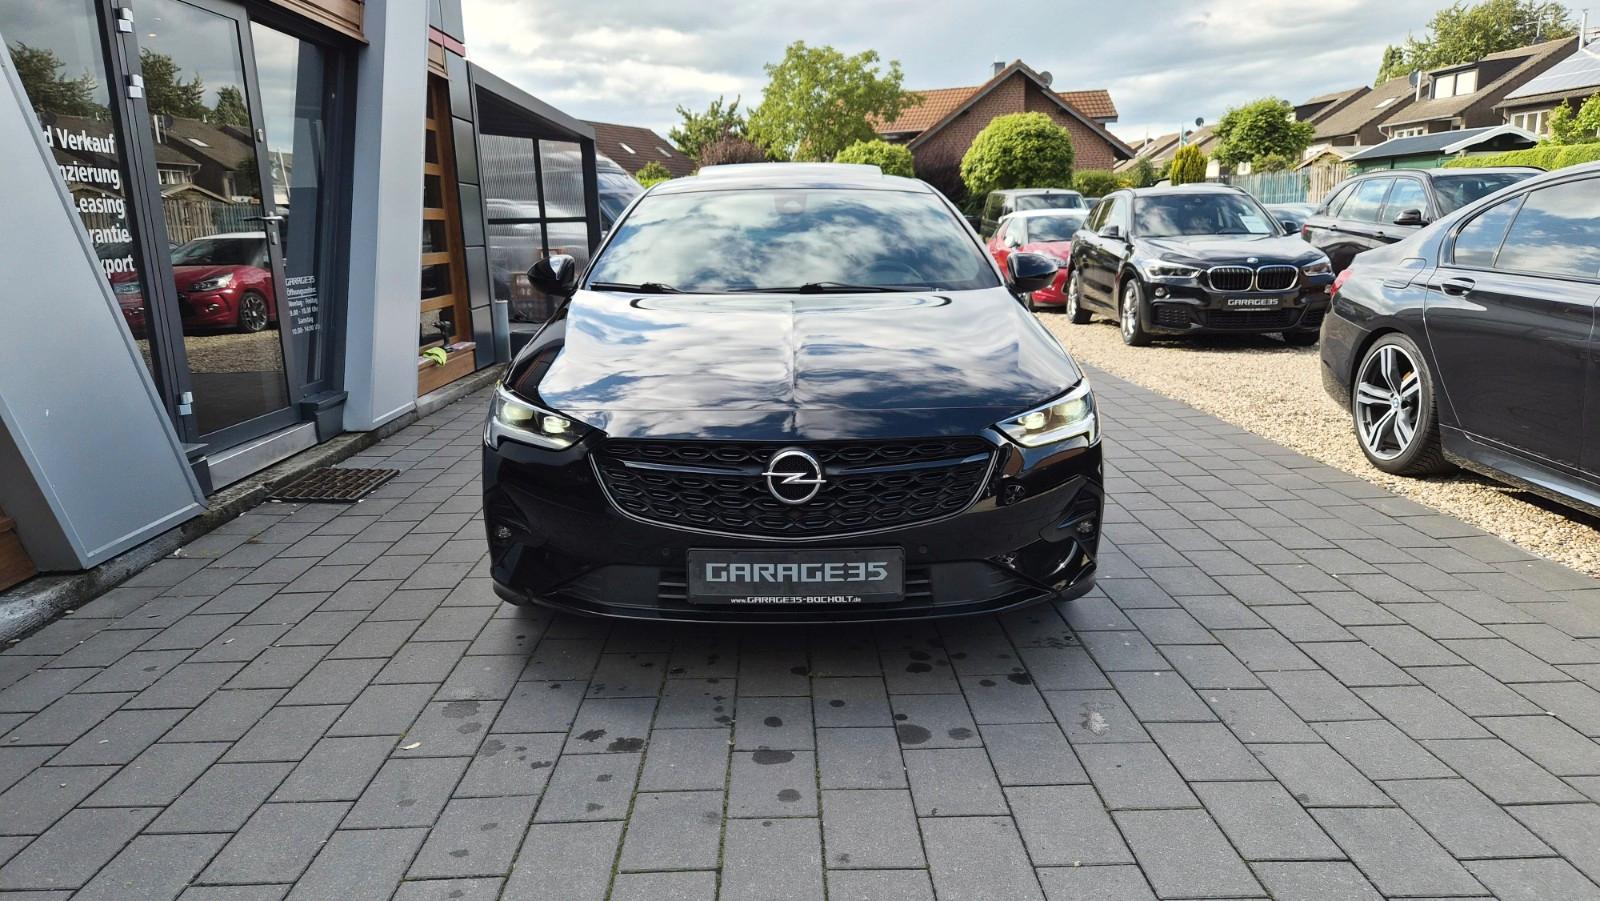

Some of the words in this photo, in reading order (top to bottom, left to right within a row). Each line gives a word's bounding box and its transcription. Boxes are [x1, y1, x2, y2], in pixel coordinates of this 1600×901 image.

[56, 127, 115, 154] Verkauf
[1227, 298, 1279, 306] GARAGE35
[706, 562, 888, 582] GARAGE35
[730, 595, 861, 604] www.GARAGE35-BOCHOLT.de
